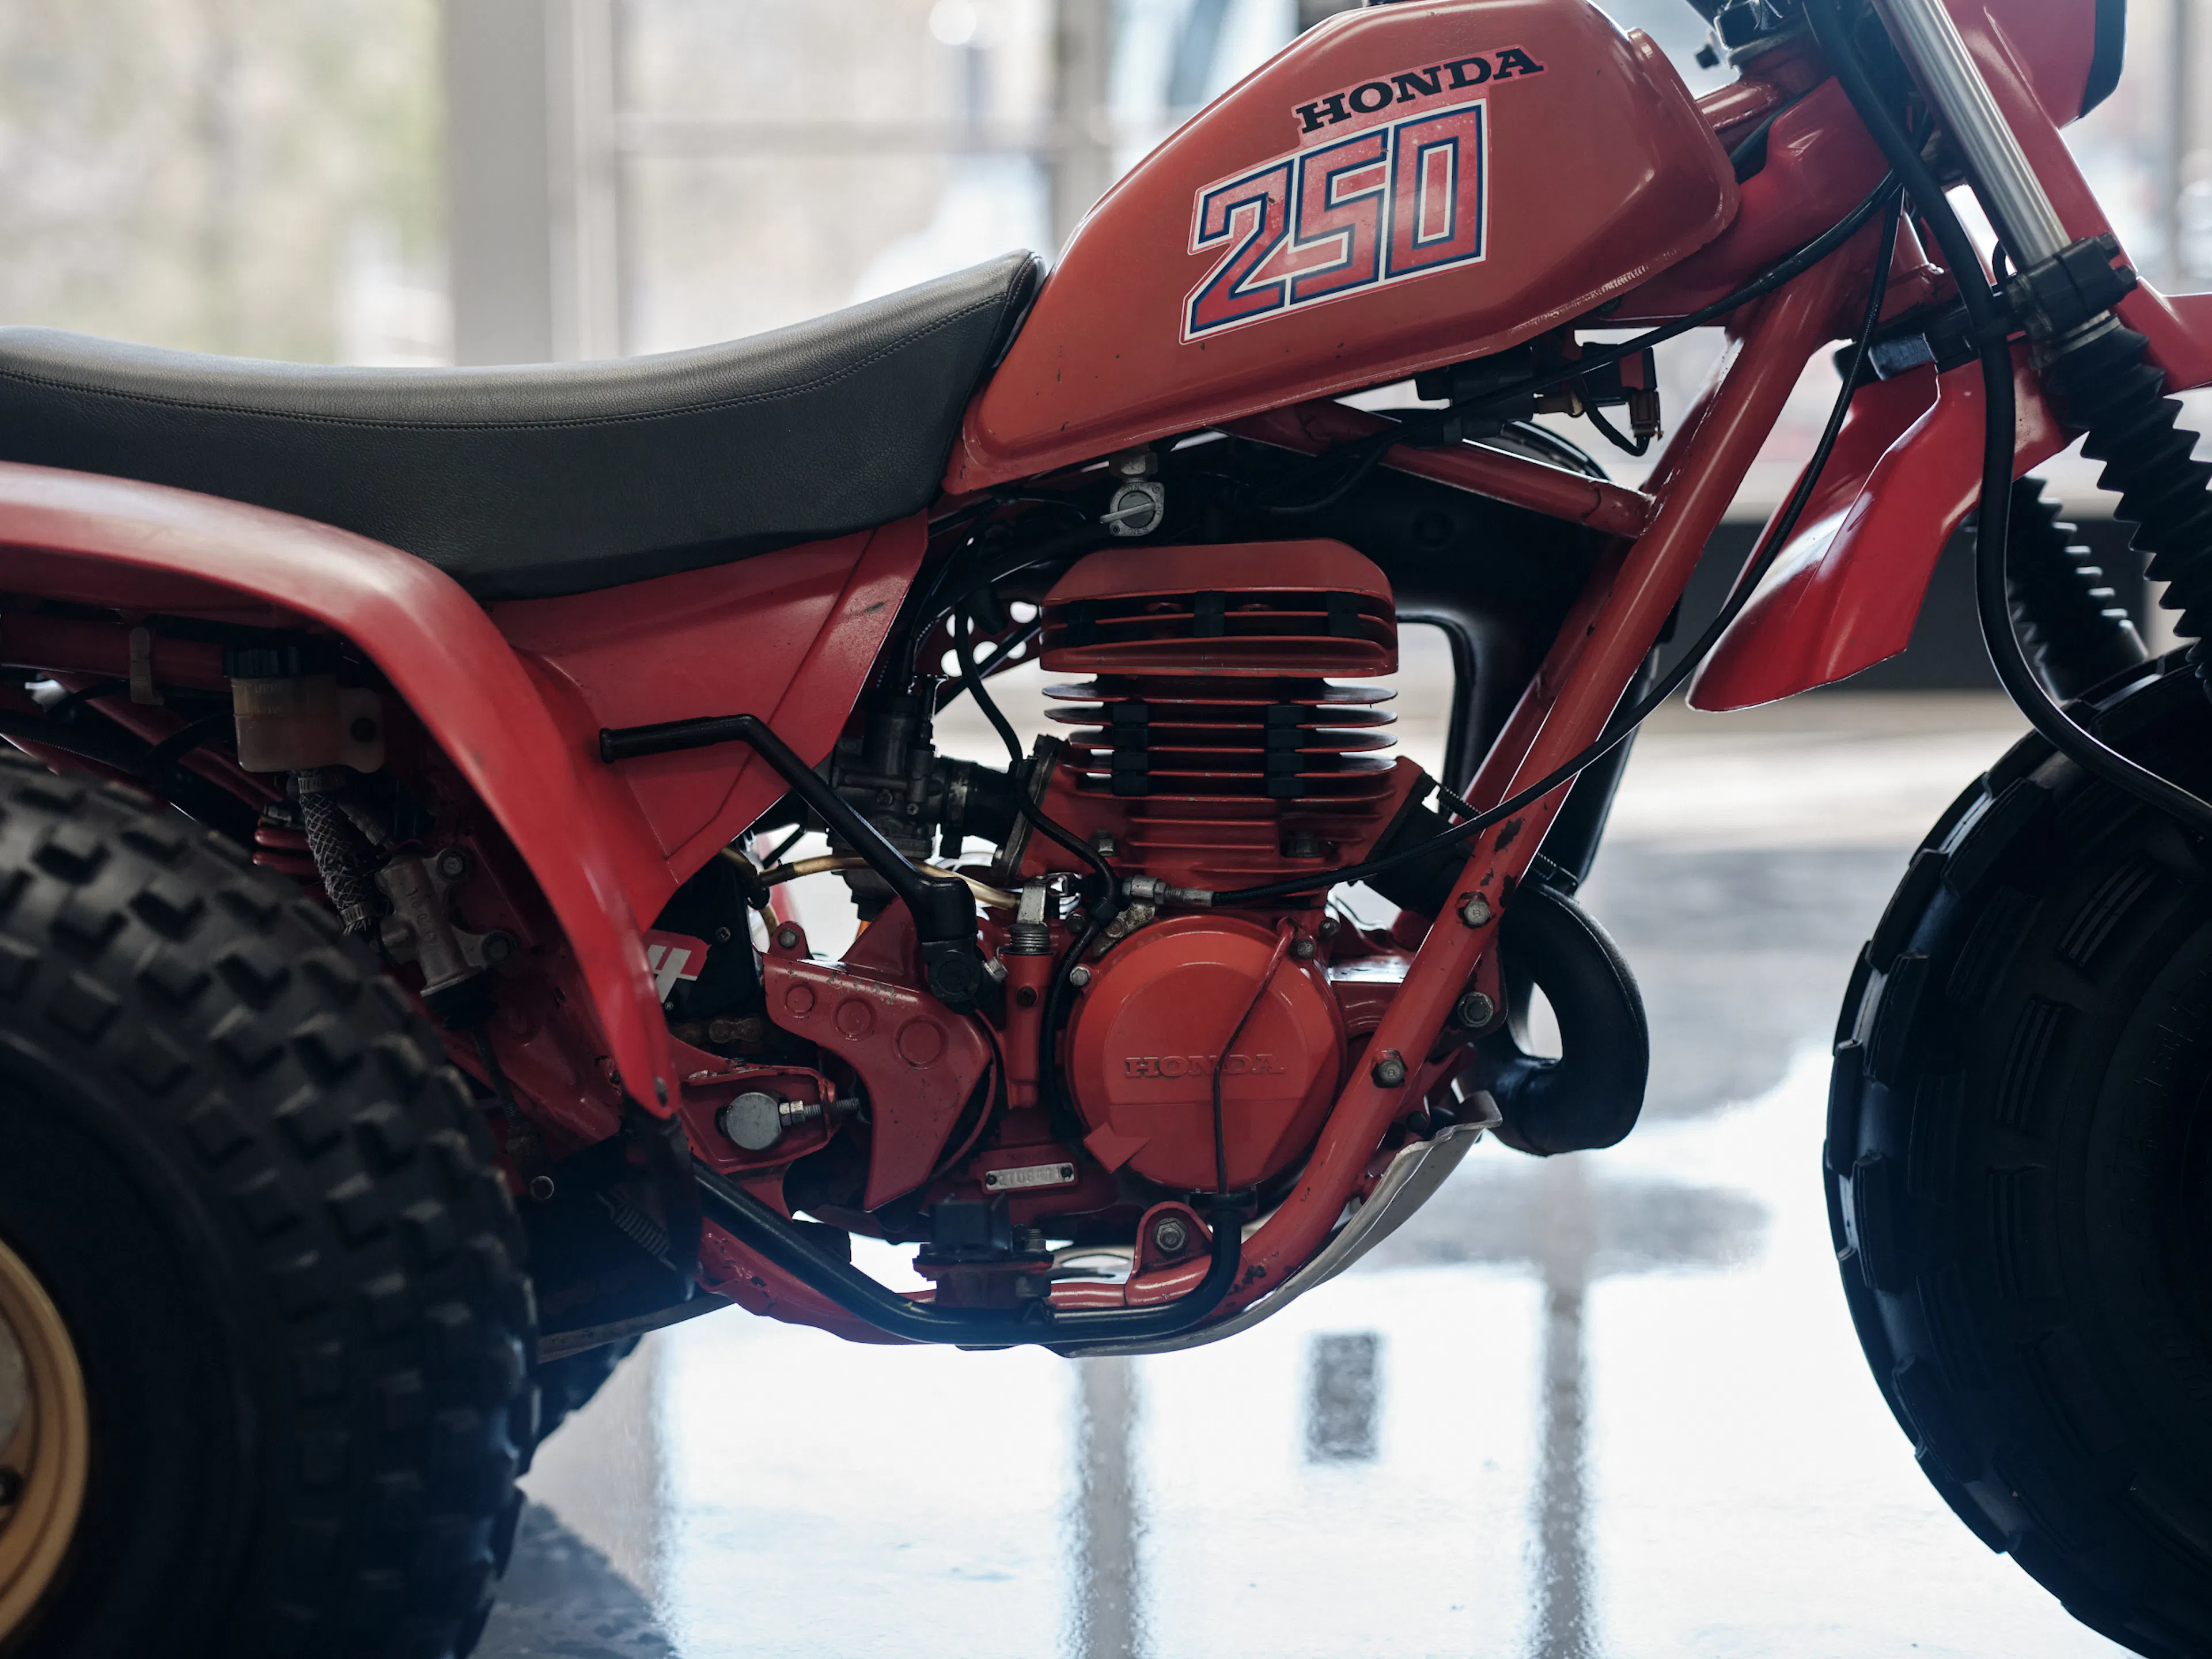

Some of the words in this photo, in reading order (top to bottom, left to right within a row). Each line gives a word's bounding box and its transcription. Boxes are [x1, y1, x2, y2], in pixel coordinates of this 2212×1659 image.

[1296, 47, 1545, 134] HONDA
[1183, 99, 1487, 343] 250
[1125, 1054, 1285, 1077] HONDA
